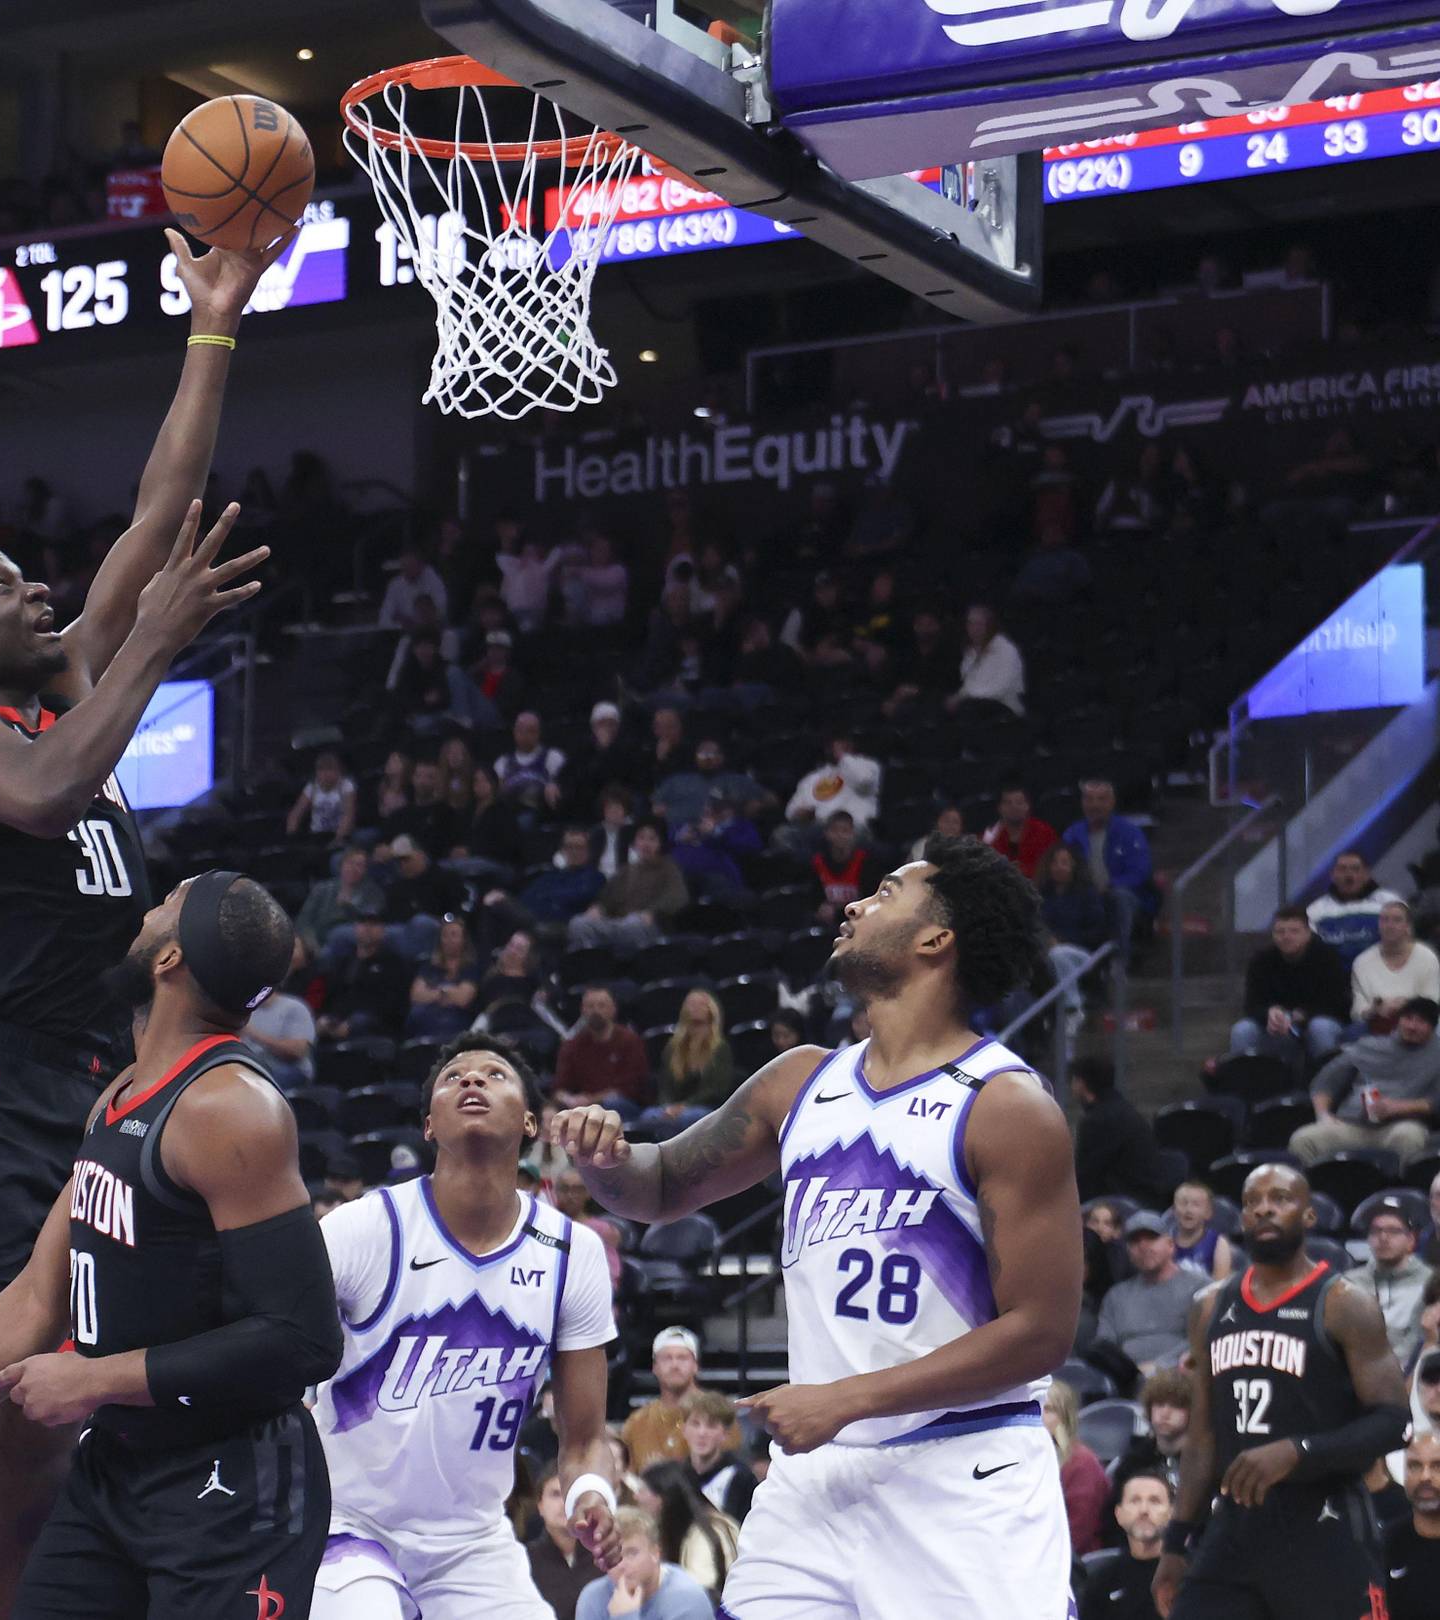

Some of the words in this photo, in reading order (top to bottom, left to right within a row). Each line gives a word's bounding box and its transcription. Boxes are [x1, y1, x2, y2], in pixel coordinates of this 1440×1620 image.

[1047, 153, 1132, 199] (92%)
[1179, 143, 1203, 177] 9
[1246, 131, 1289, 168] 24
[1323, 119, 1368, 156] 33
[1401, 109, 1440, 146] 30
[658, 208, 738, 252] (43%)
[40, 260, 128, 332] 125
[1242, 371, 1378, 409] AMERICA
[534, 413, 908, 501] HealthEquity
[66, 819, 133, 897] 30
[907, 1096, 952, 1121] LVT
[70, 1160, 135, 1247] USTON
[510, 1266, 547, 1288] LVT
[834, 1248, 922, 1326] 28
[1210, 1329, 1308, 1378] HOUSTON
[469, 1396, 524, 1451] 19
[1232, 1378, 1273, 1434] 32
